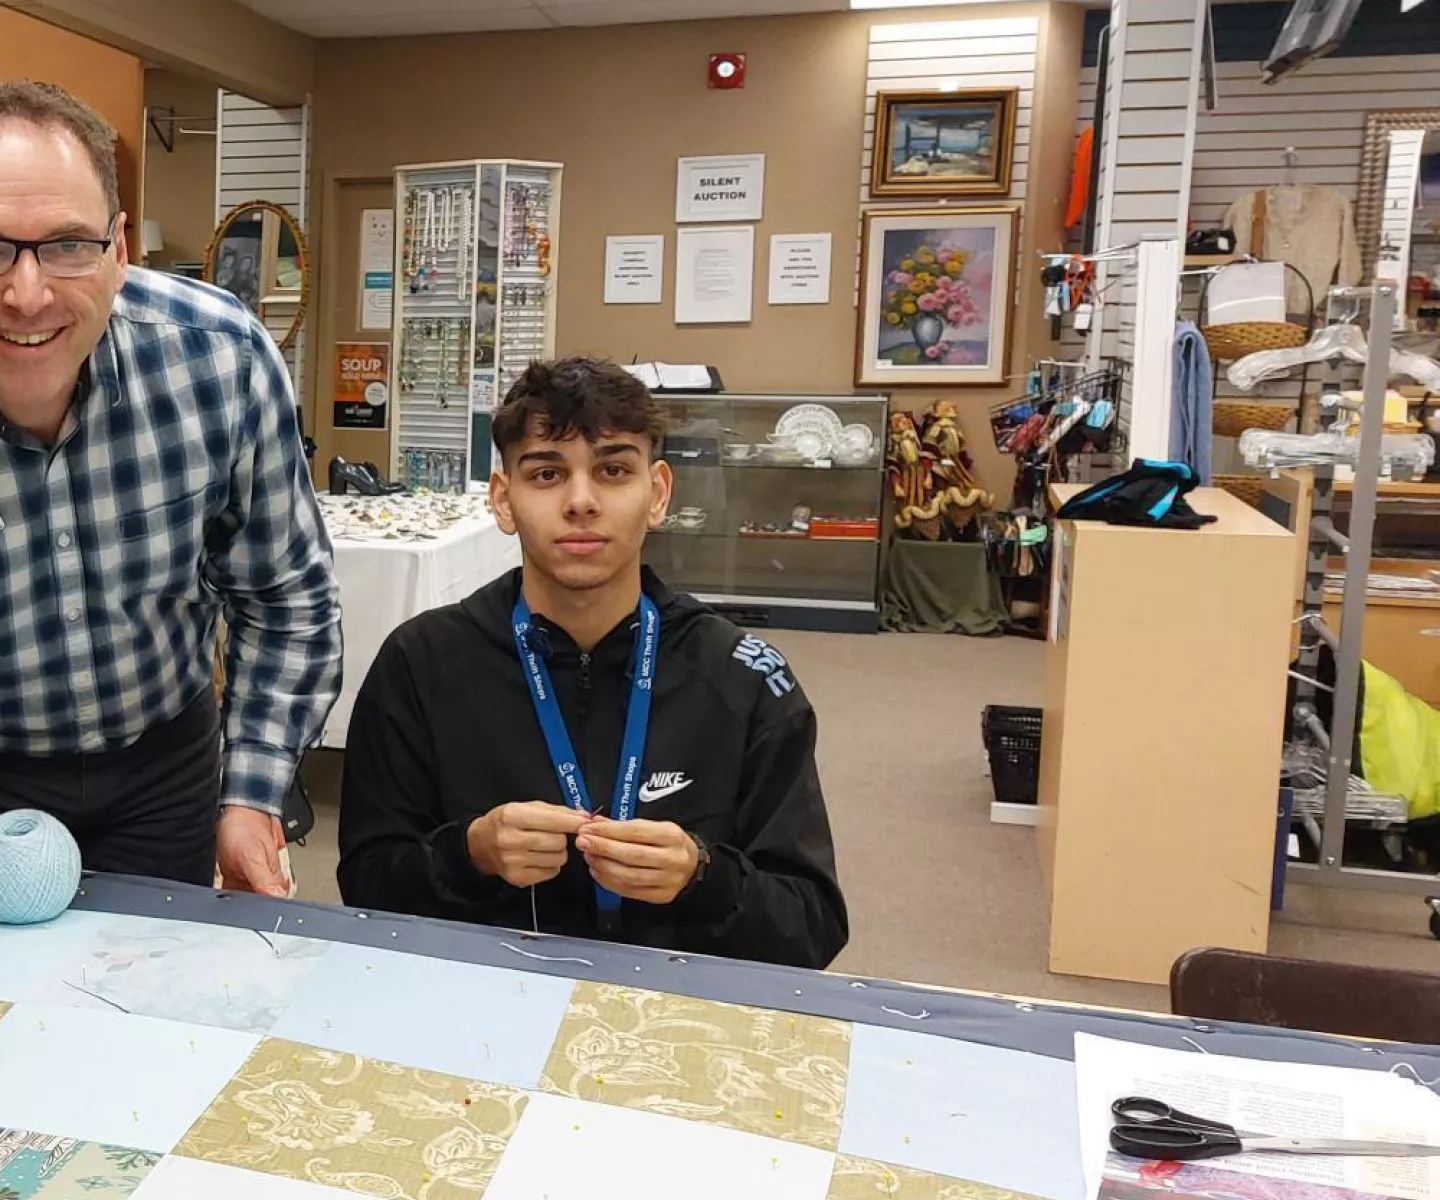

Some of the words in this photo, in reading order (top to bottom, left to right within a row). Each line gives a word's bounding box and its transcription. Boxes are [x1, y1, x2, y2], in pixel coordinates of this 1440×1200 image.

[699, 177, 742, 187] SILENT
[693, 191, 747, 201] AUCTION
[341, 358, 382, 371] SOUP
[641, 658, 650, 677] MCC
[751, 647, 786, 676] DO
[624, 756, 637, 782] Shops
[648, 771, 685, 788] NIKE
